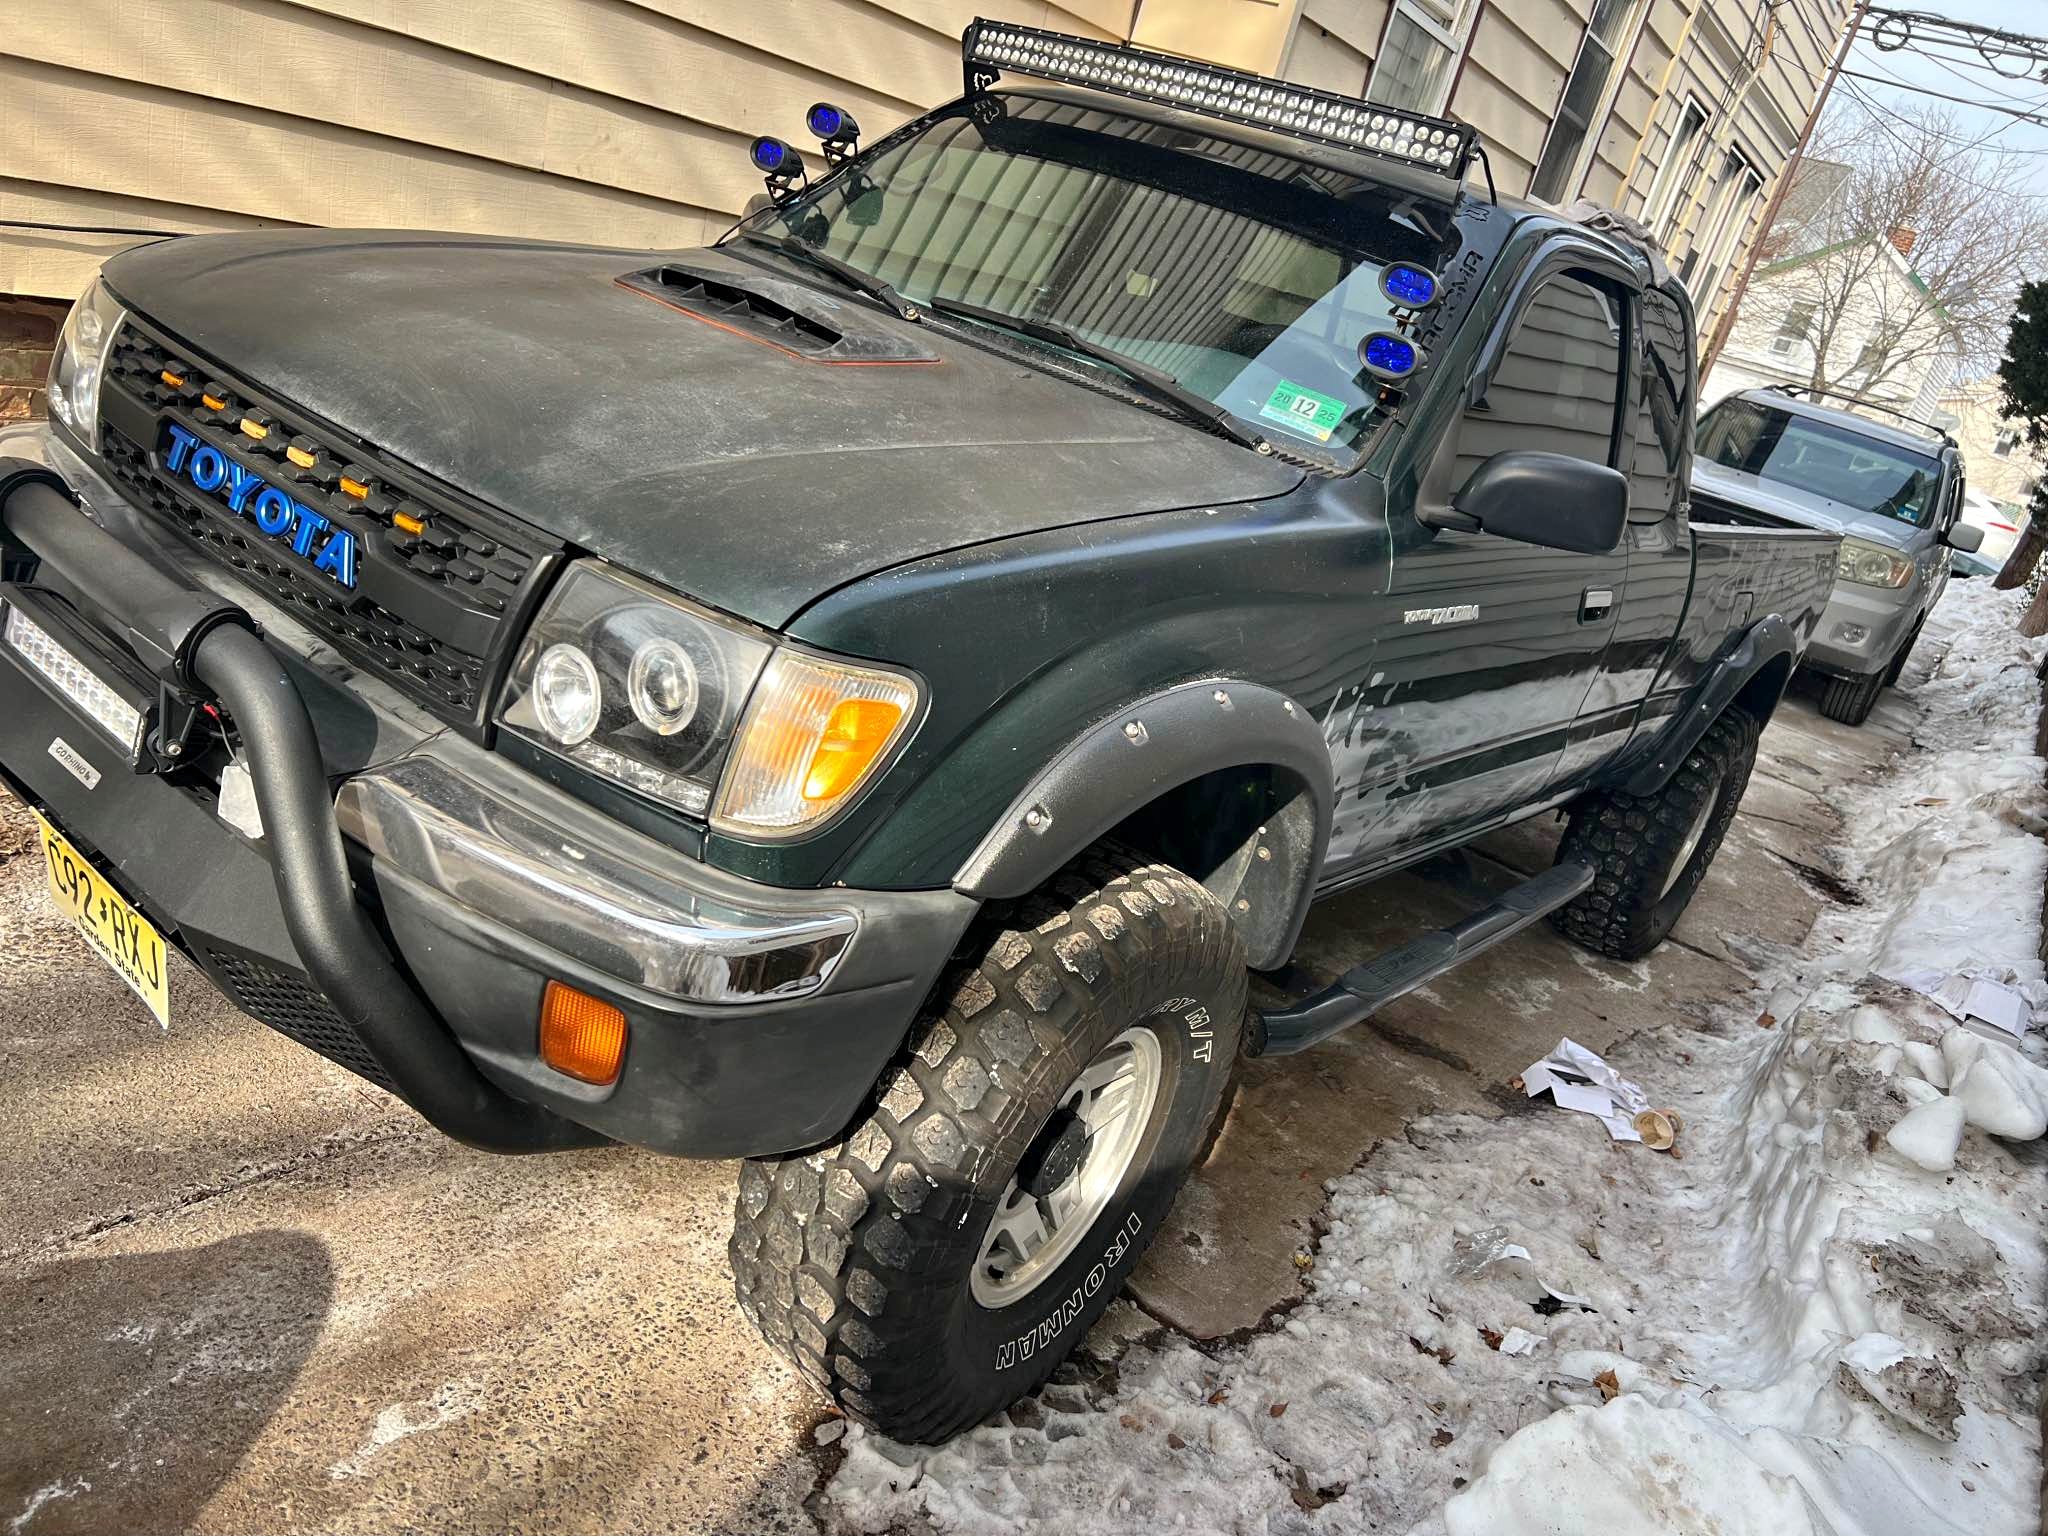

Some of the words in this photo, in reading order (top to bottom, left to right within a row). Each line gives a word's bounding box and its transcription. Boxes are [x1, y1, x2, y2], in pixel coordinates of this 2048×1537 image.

[1293, 398, 1316, 417] 12
[1318, 409, 1337, 422] 25
[165, 422, 359, 589] TOYOTA
[78, 914, 112, 958] Garden
[114, 952, 141, 988] State
[1184, 1006, 1214, 1063] M/T
[995, 1211, 1143, 1371] IRONMAN
